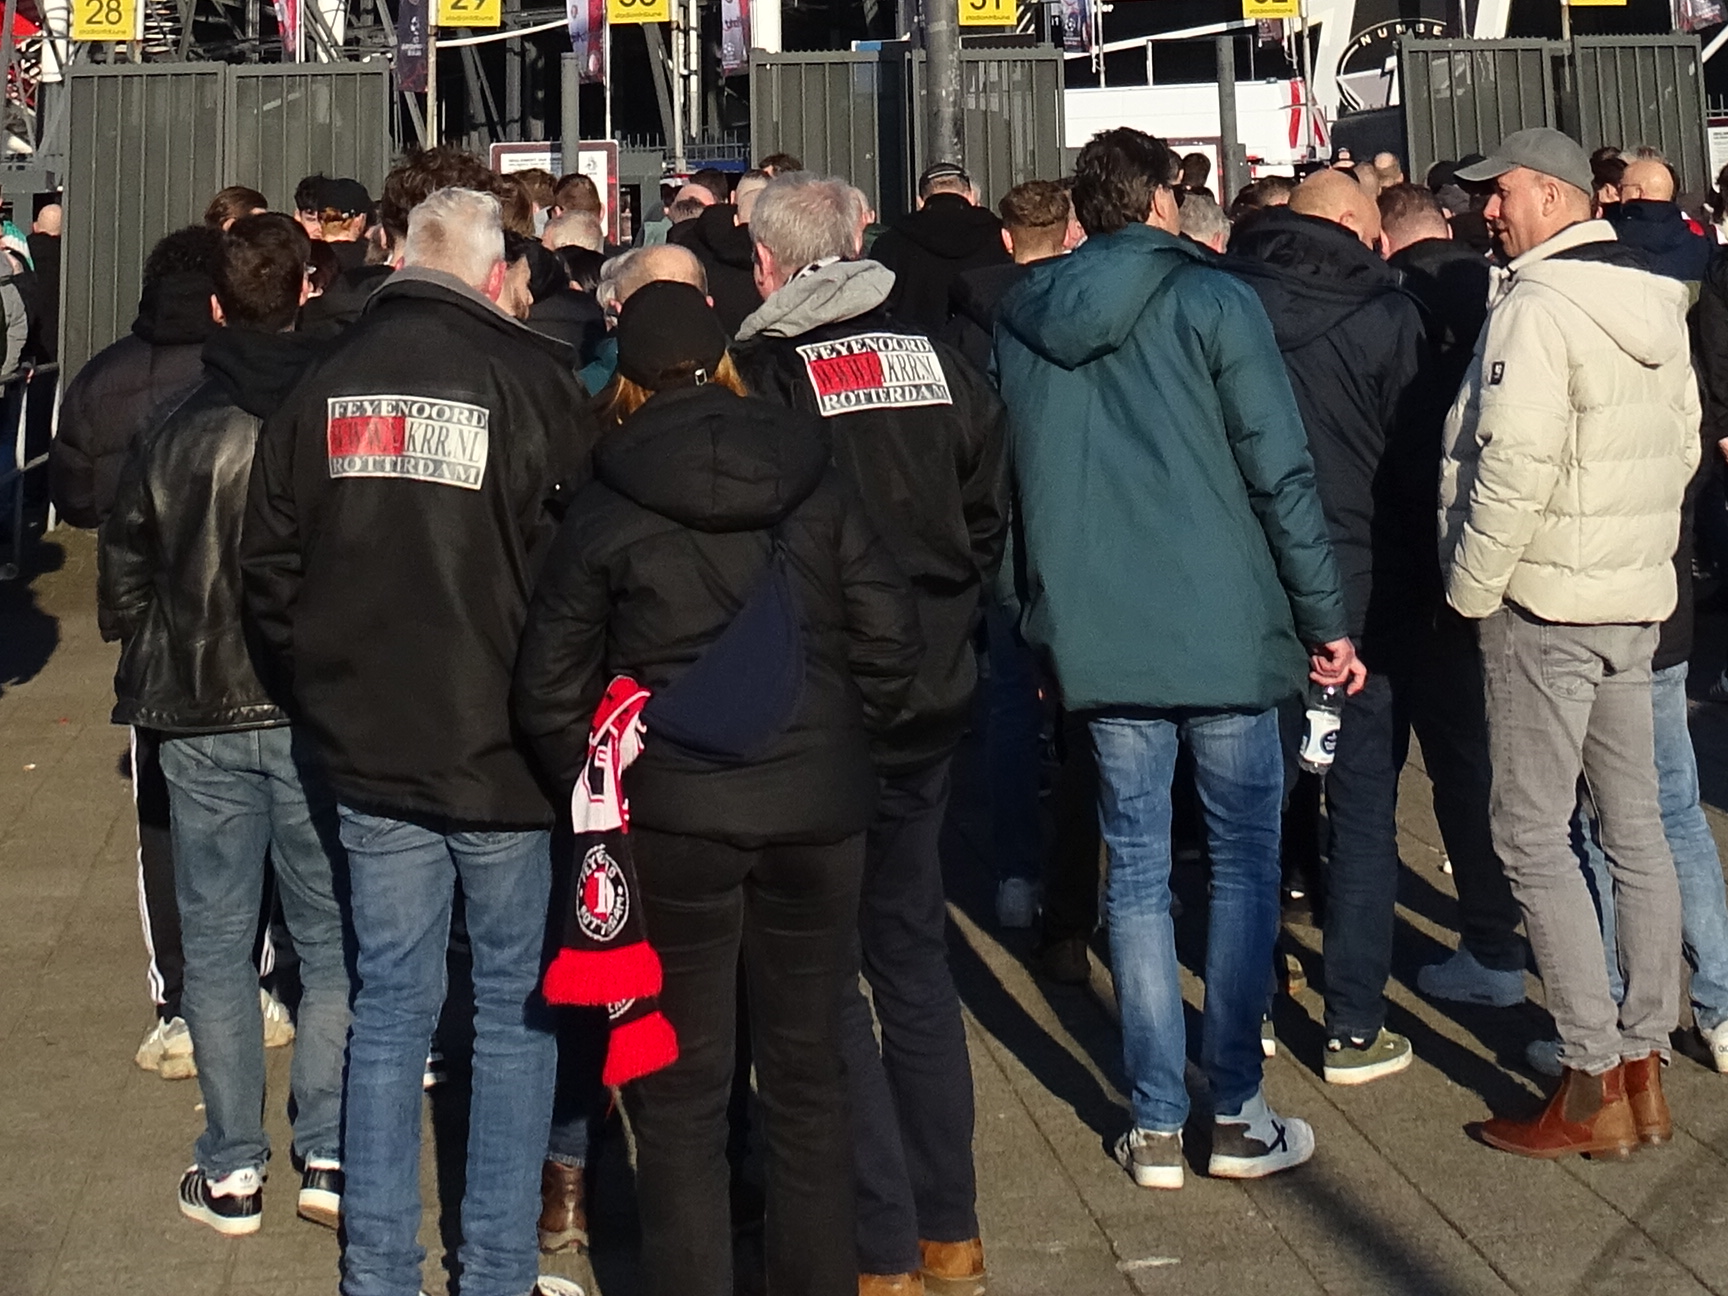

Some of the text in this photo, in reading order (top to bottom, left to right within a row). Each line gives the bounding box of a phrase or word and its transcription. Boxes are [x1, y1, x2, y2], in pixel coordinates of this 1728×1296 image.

[804, 338, 934, 361] FEYENOORD
[823, 383, 947, 410] ROTTERDAM
[334, 401, 486, 428] FEYENOORD
